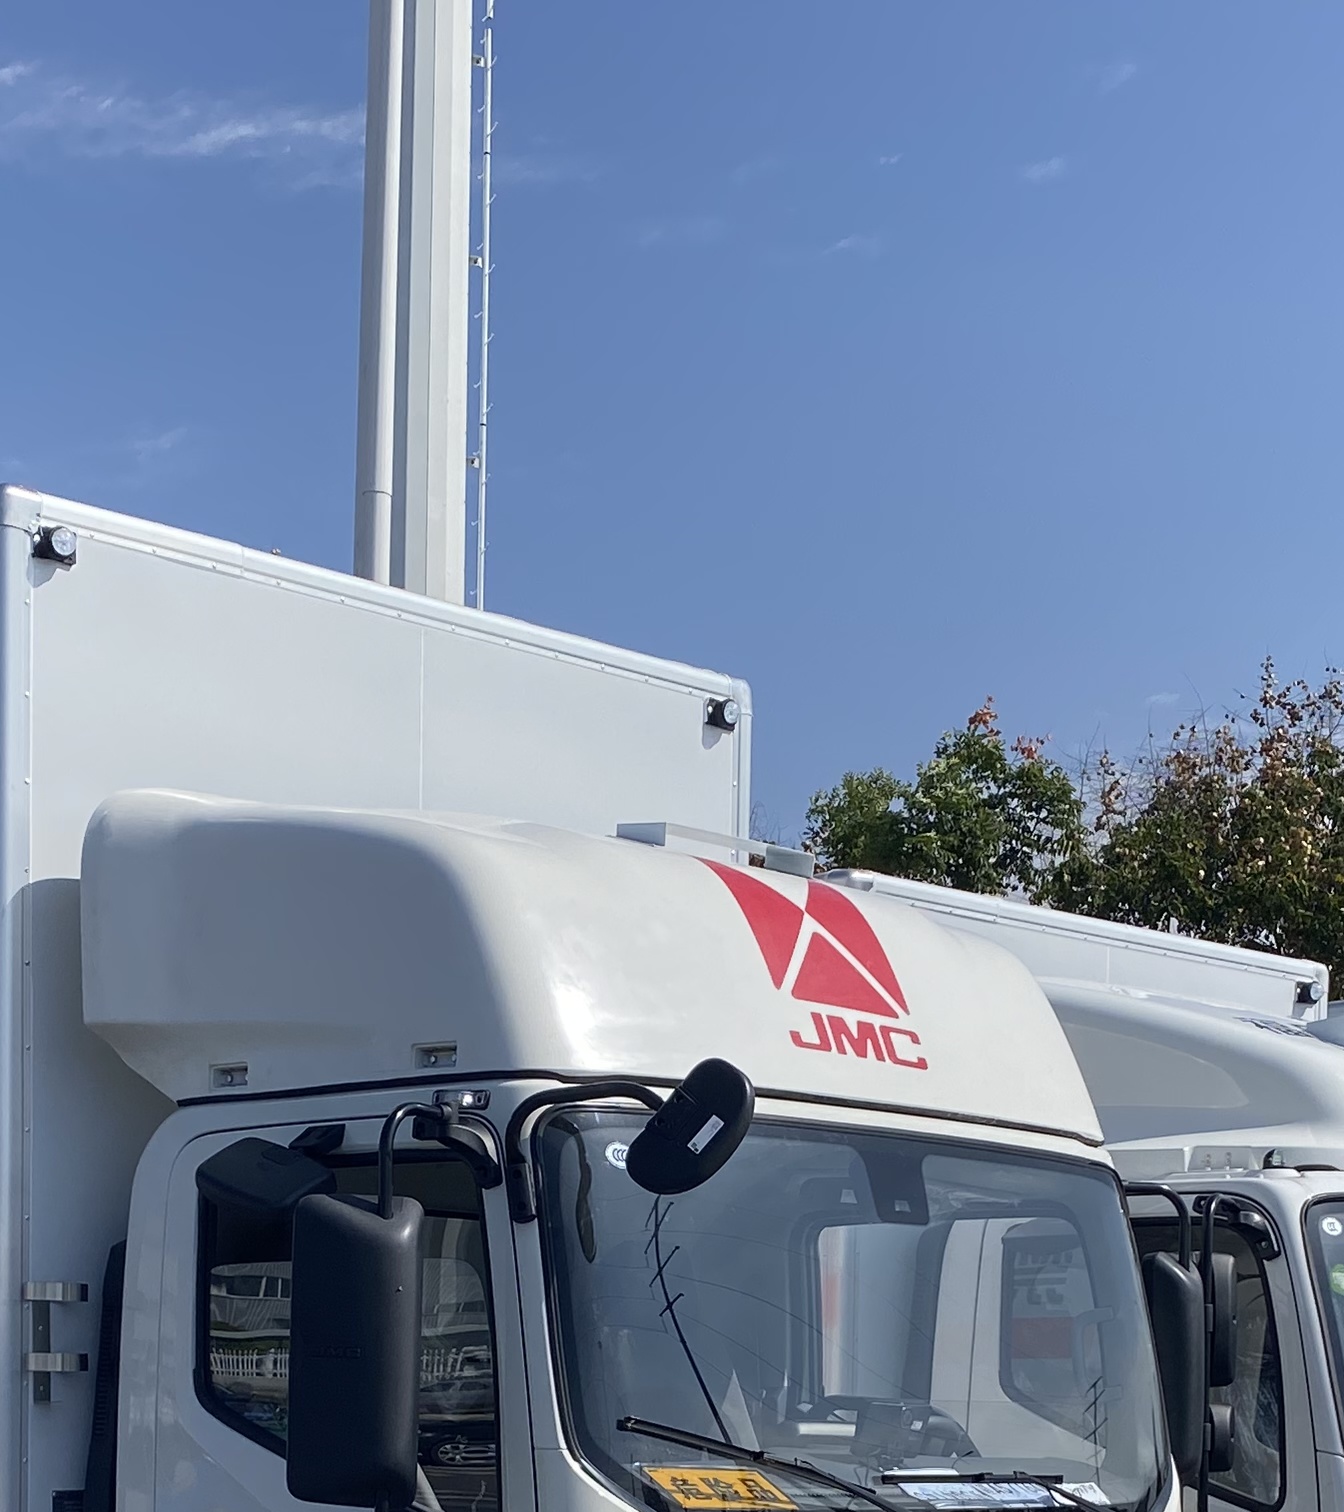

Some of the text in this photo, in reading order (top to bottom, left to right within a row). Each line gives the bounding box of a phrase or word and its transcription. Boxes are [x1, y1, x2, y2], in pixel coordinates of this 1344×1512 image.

[789, 1012, 928, 1070] JMC
[670, 1475, 777, 1501] 危险品
